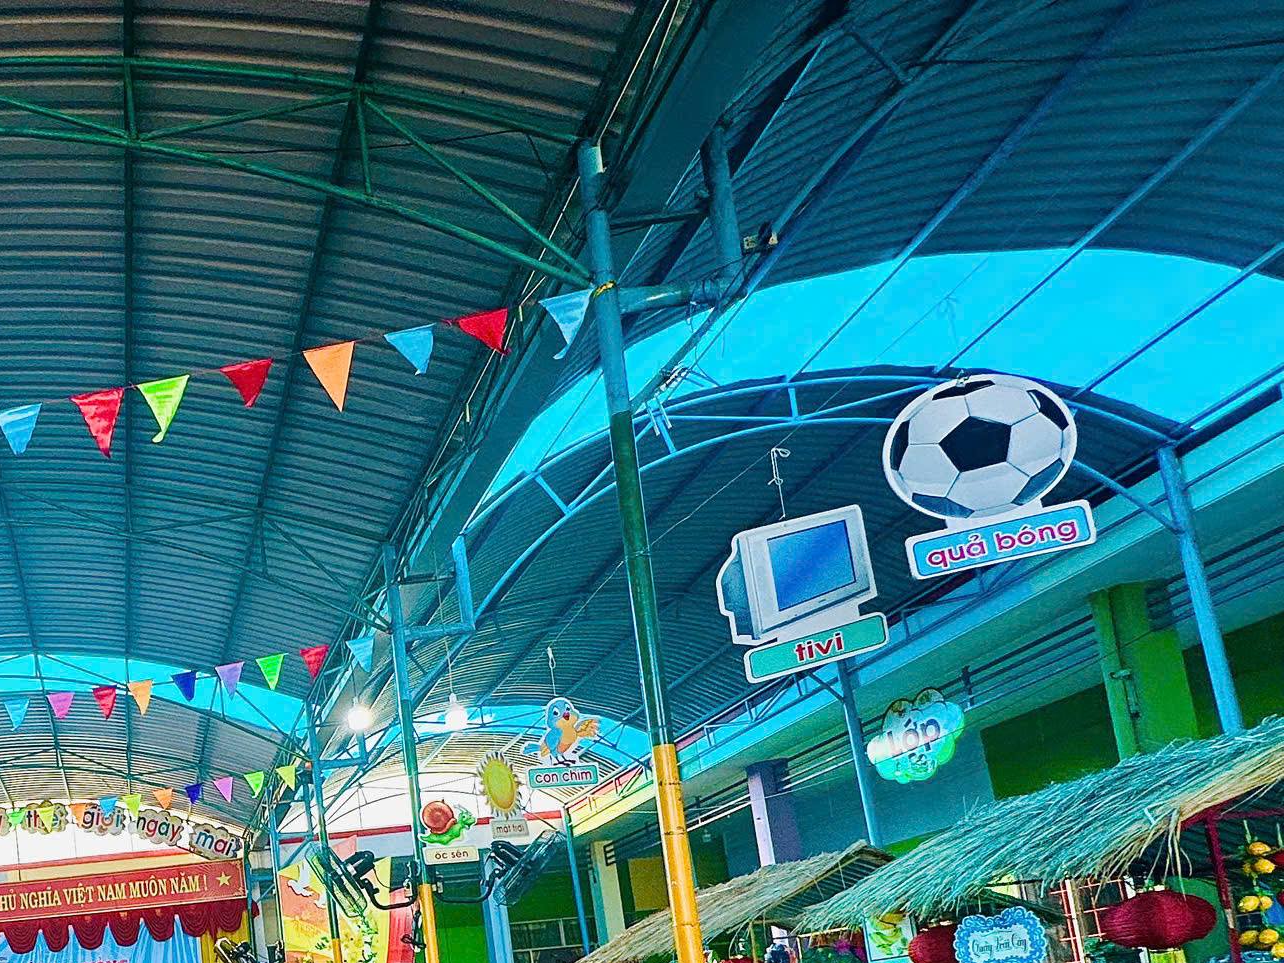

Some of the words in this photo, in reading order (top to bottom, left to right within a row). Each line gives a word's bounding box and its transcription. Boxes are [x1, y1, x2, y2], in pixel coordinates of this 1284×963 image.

[927, 535, 987, 568] quả
[995, 520, 1078, 552] bóng
[796, 632, 844, 661] tivi
[535, 772, 559, 784] con
[563, 769, 593, 783] chim
[137, 816, 182, 841] ngày
[196, 830, 236, 857] mai
[20, 886, 62, 910] NGHĨA
[63, 882, 94, 907] VIỆT
[98, 882, 126, 901] NAM
[128, 875, 167, 898] MUÔN
[170, 872, 201, 895] NĂM
